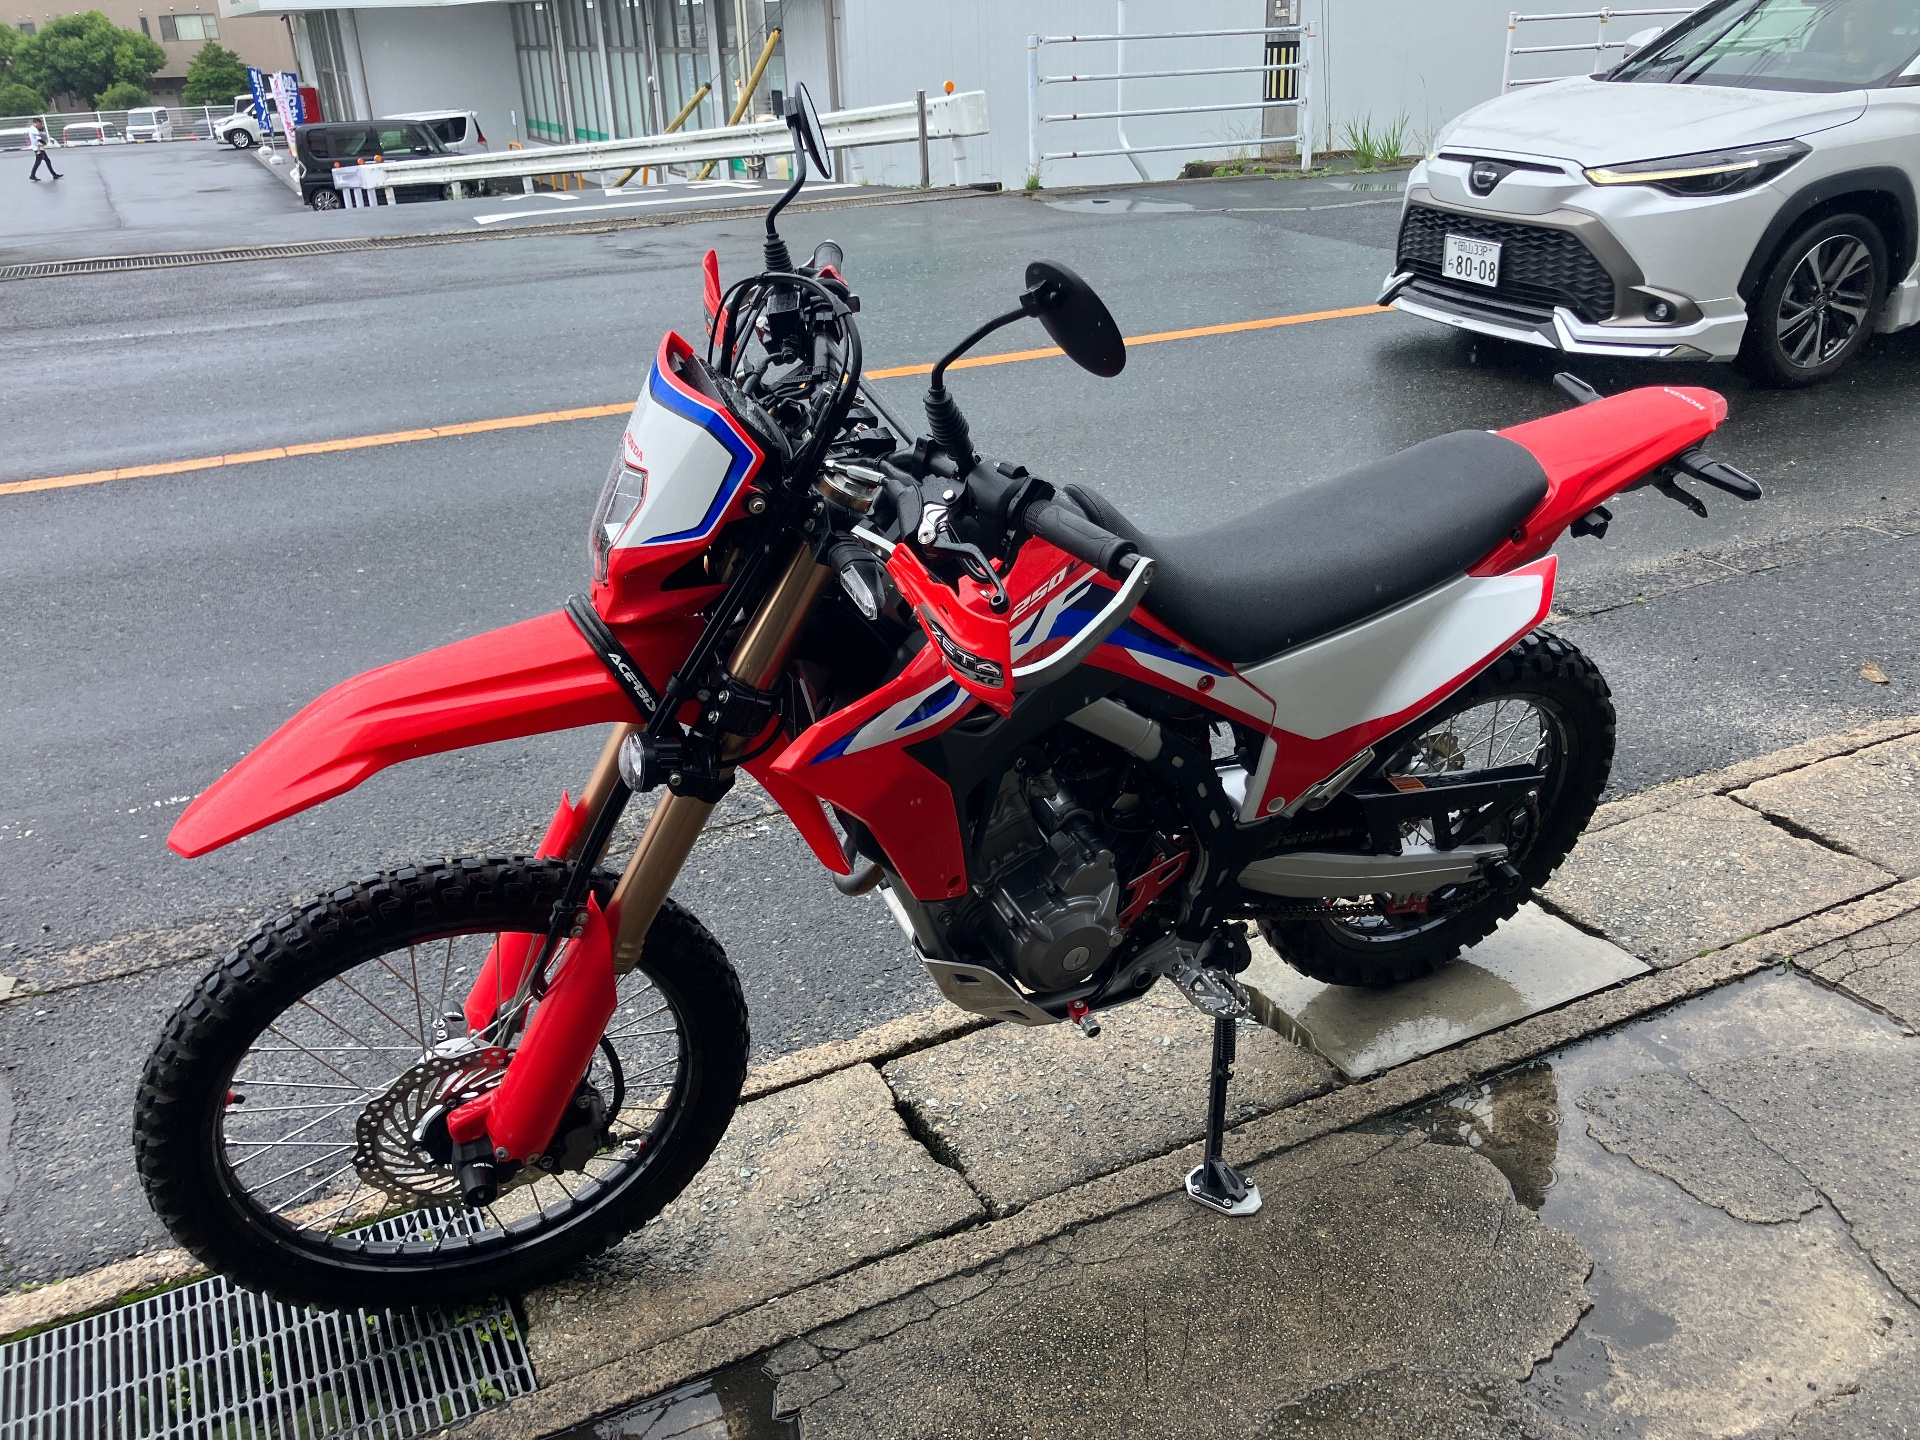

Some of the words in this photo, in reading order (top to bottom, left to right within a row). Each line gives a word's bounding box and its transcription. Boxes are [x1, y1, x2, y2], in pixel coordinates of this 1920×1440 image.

[1455, 254, 1496, 283] 80-08
[1663, 387, 1706, 411] HONDA
[930, 622, 1002, 677] ZETA
[607, 653, 657, 712] ACERBIS
